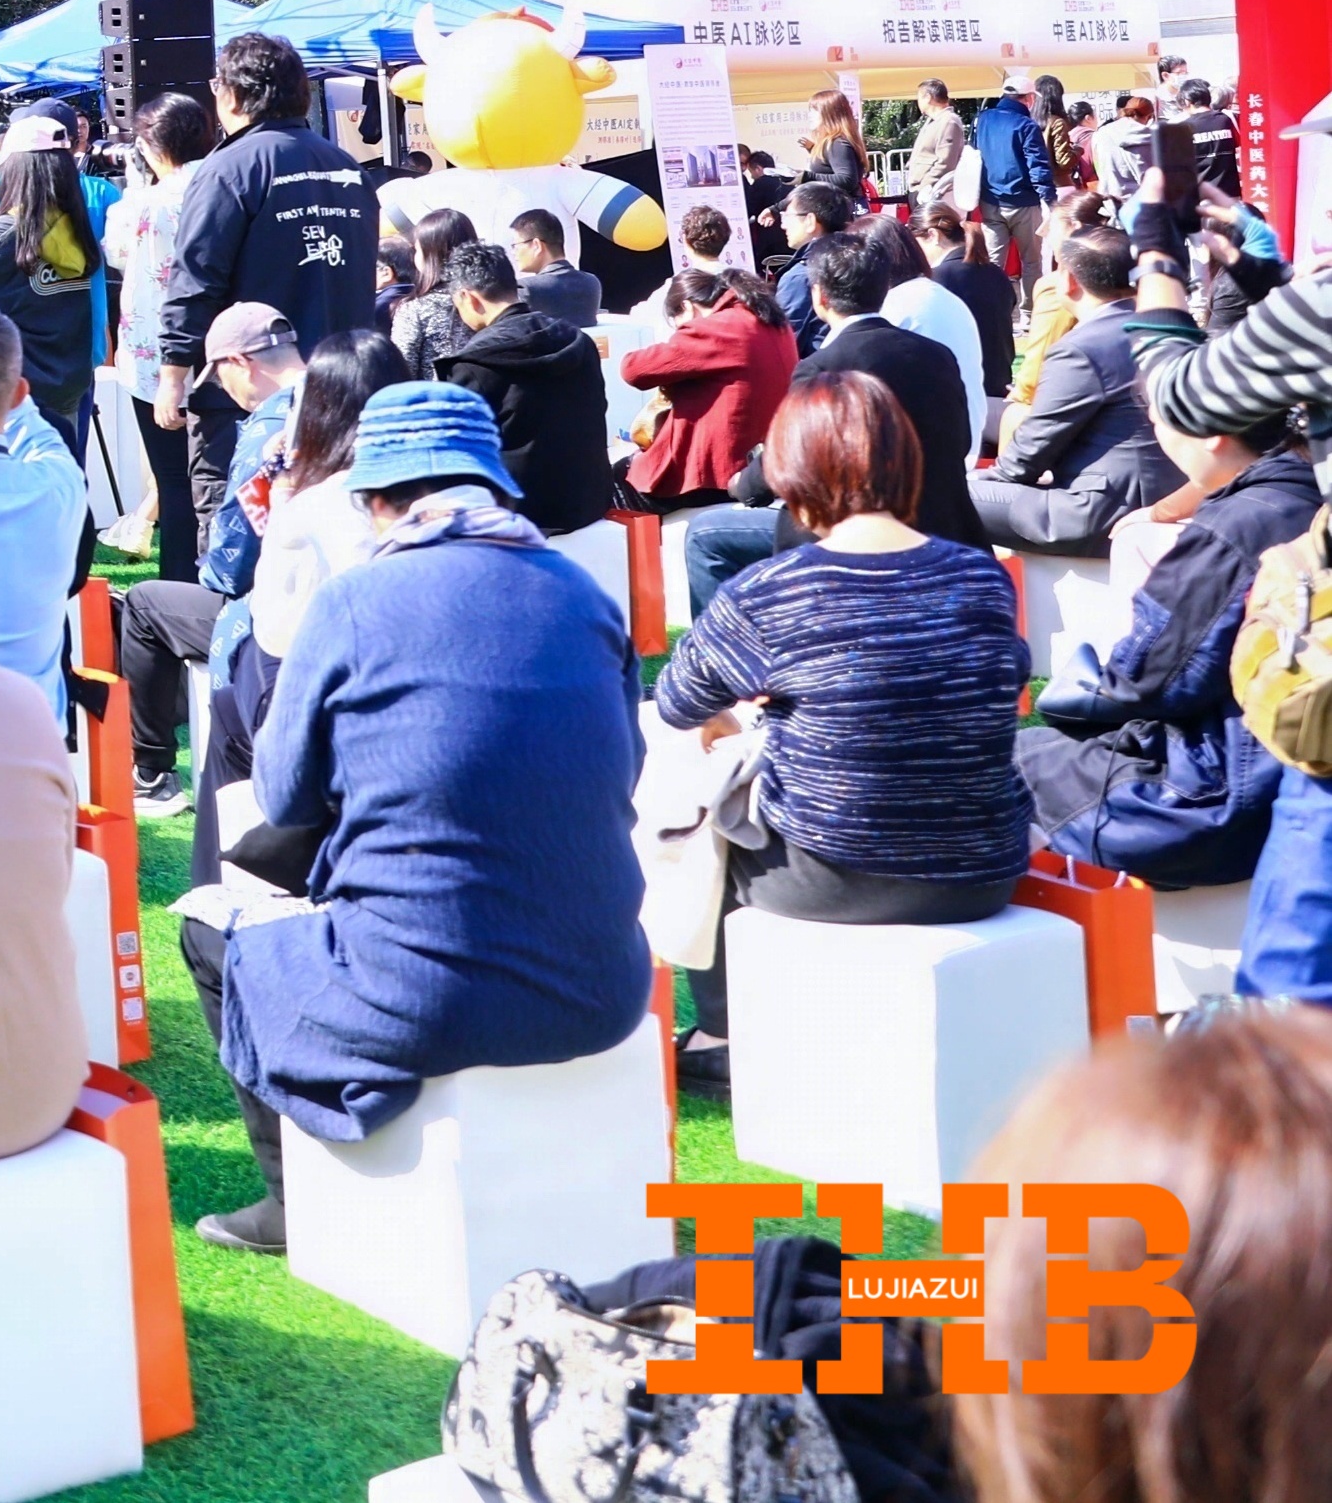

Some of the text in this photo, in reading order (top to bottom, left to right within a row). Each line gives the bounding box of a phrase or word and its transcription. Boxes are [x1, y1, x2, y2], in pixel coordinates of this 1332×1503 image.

[693, 20, 802, 46] 中医AI脉诊区
[882, 19, 982, 43] 报告解读调理区
[1053, 19, 1129, 42] 中医AI脉诊区
[275, 207, 304, 222] FIRST
